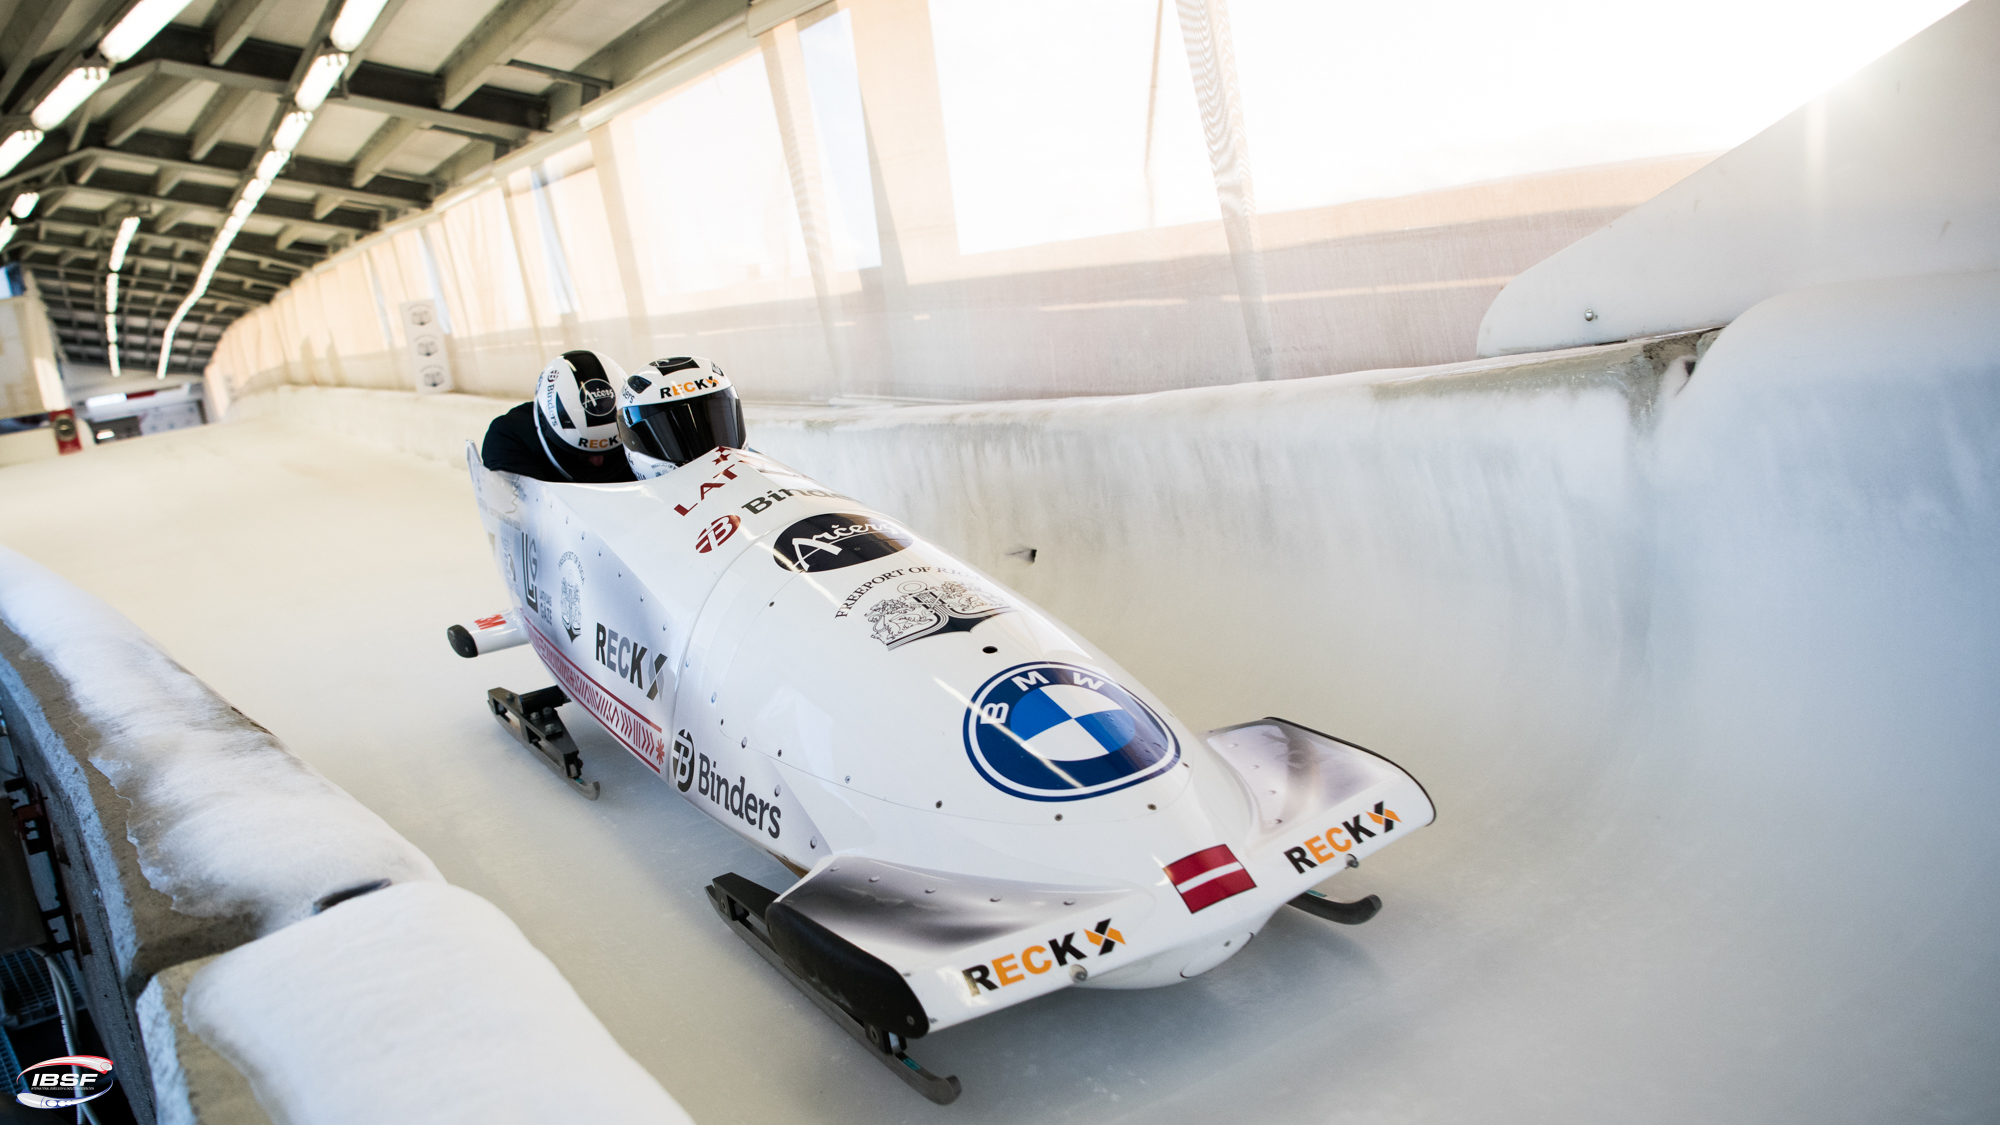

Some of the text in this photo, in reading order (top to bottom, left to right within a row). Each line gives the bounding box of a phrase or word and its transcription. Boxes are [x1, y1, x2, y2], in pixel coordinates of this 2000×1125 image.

[546, 384, 558, 427] Binders
[835, 568, 905, 619] FREEPORT
[908, 566, 931, 574] OF
[980, 671, 1105, 724] BMW
[698, 752, 781, 839] Binders
